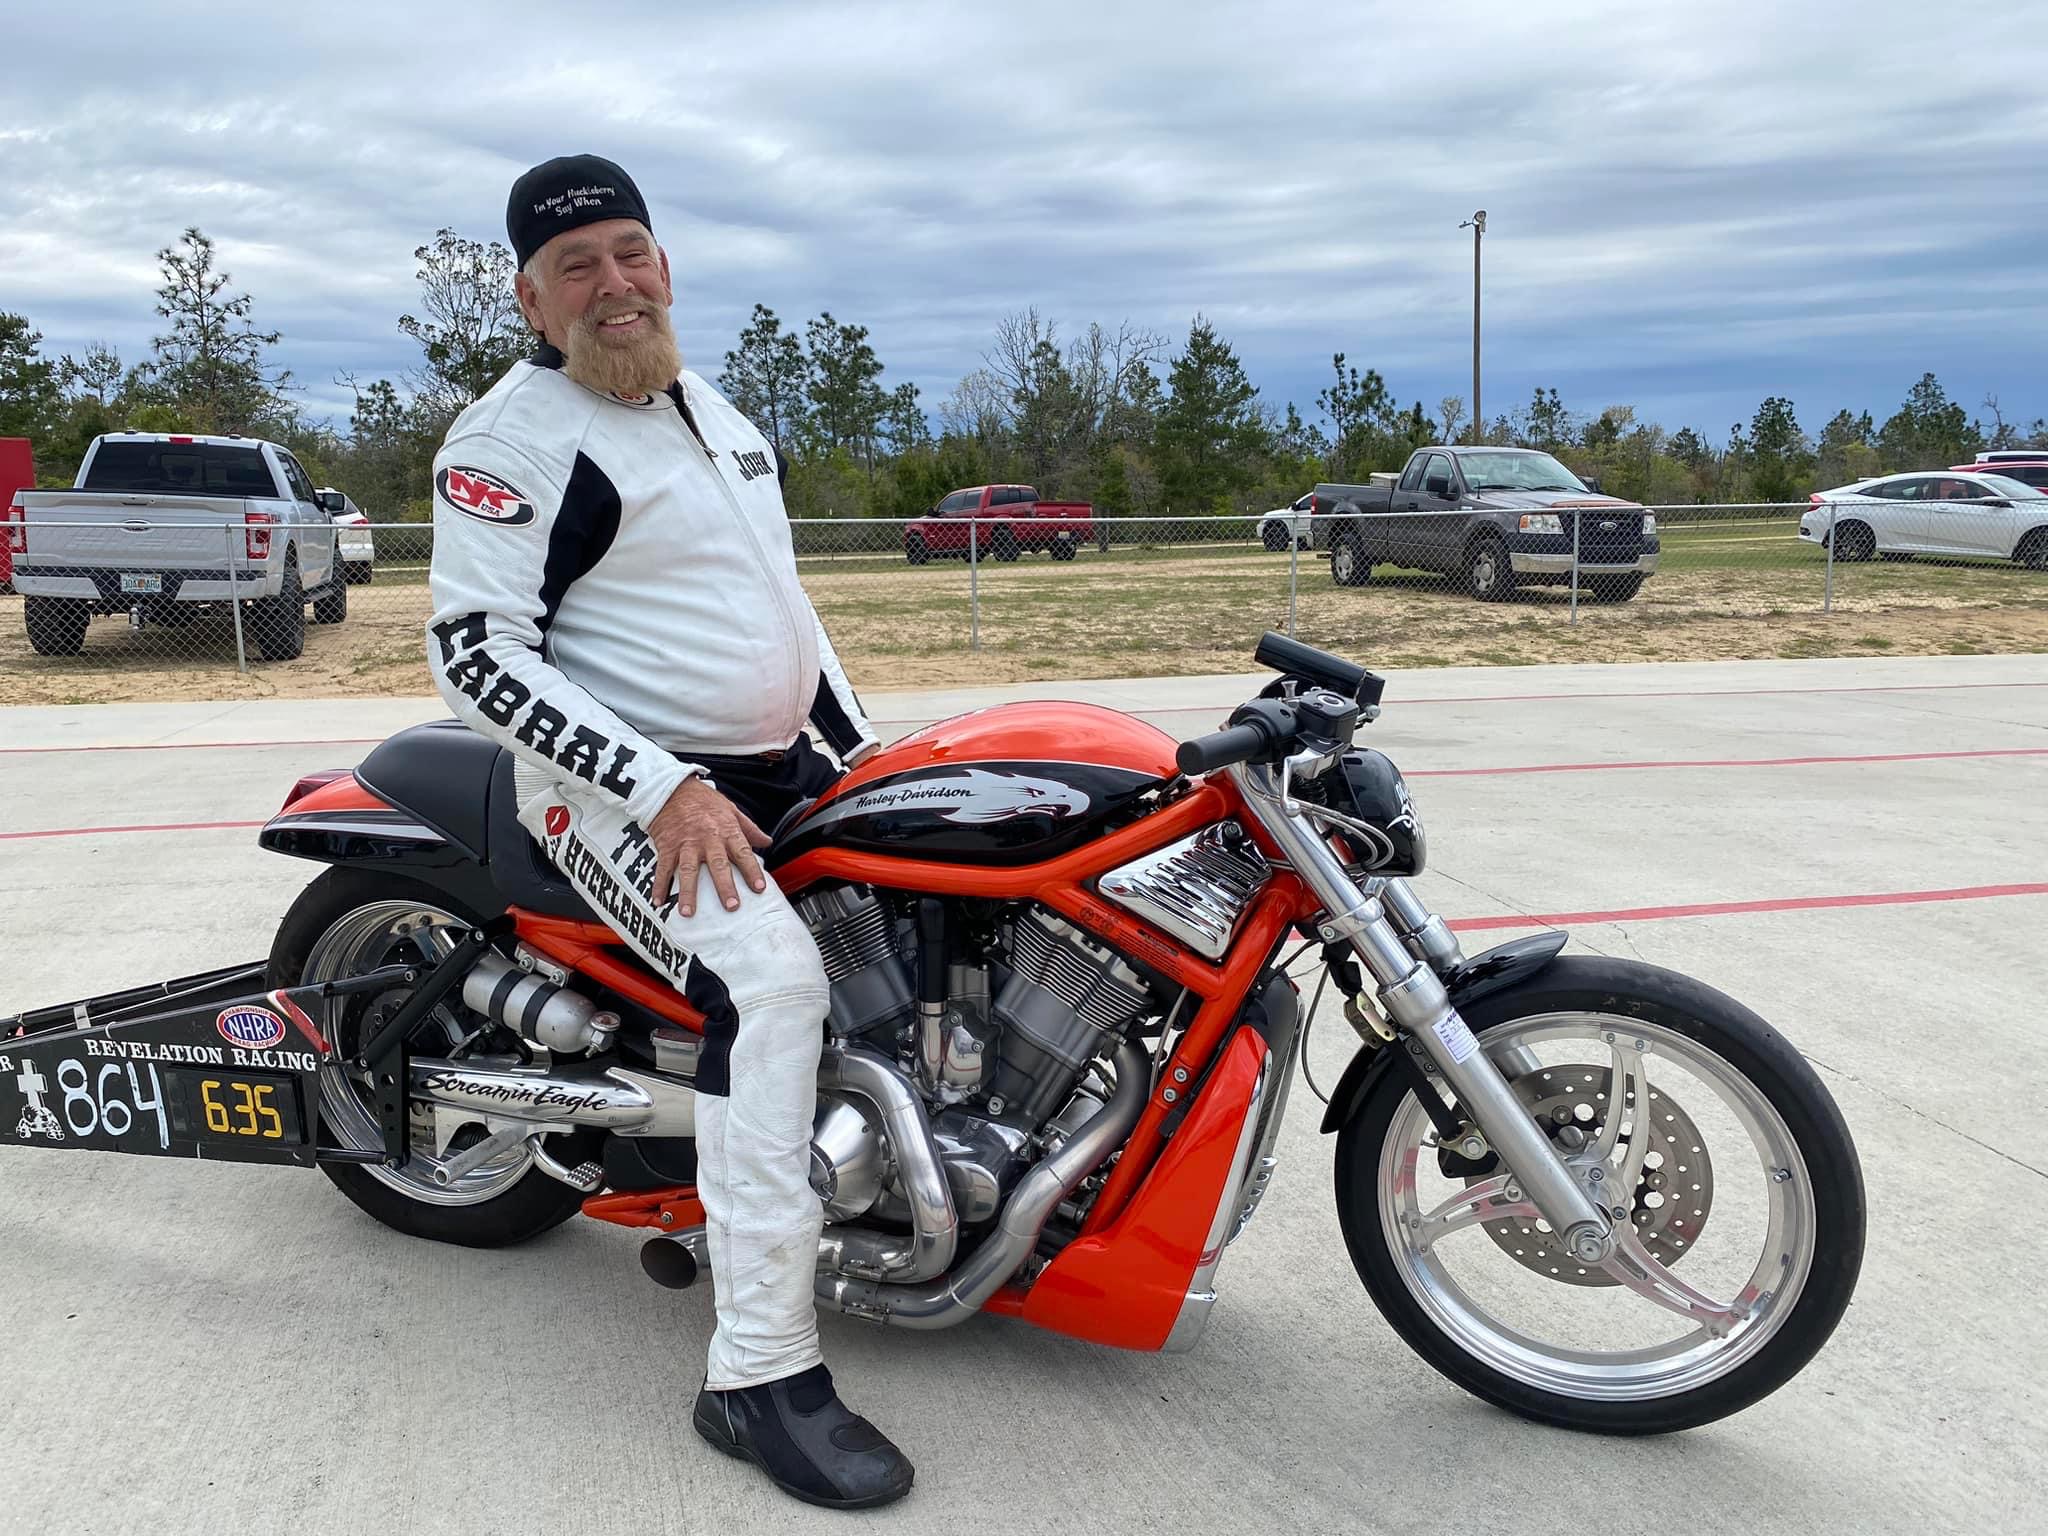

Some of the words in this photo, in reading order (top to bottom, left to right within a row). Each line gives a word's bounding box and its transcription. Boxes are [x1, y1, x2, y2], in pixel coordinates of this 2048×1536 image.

[555, 202, 573, 216] Say
[573, 196, 602, 207] When
[480, 503, 501, 517] USA
[431, 611, 638, 801] CABRAL
[855, 786, 975, 810] Harley-Davidson
[564, 830, 688, 980] HUCKLEBERRY
[227, 1014, 276, 1040] NHRA
[84, 1039, 223, 1065] REVELATION
[232, 1048, 317, 1072] RACING
[57, 1058, 170, 1150] 864
[201, 1080, 283, 1138] 6.35
[533, 1085, 609, 1115] Eagle
